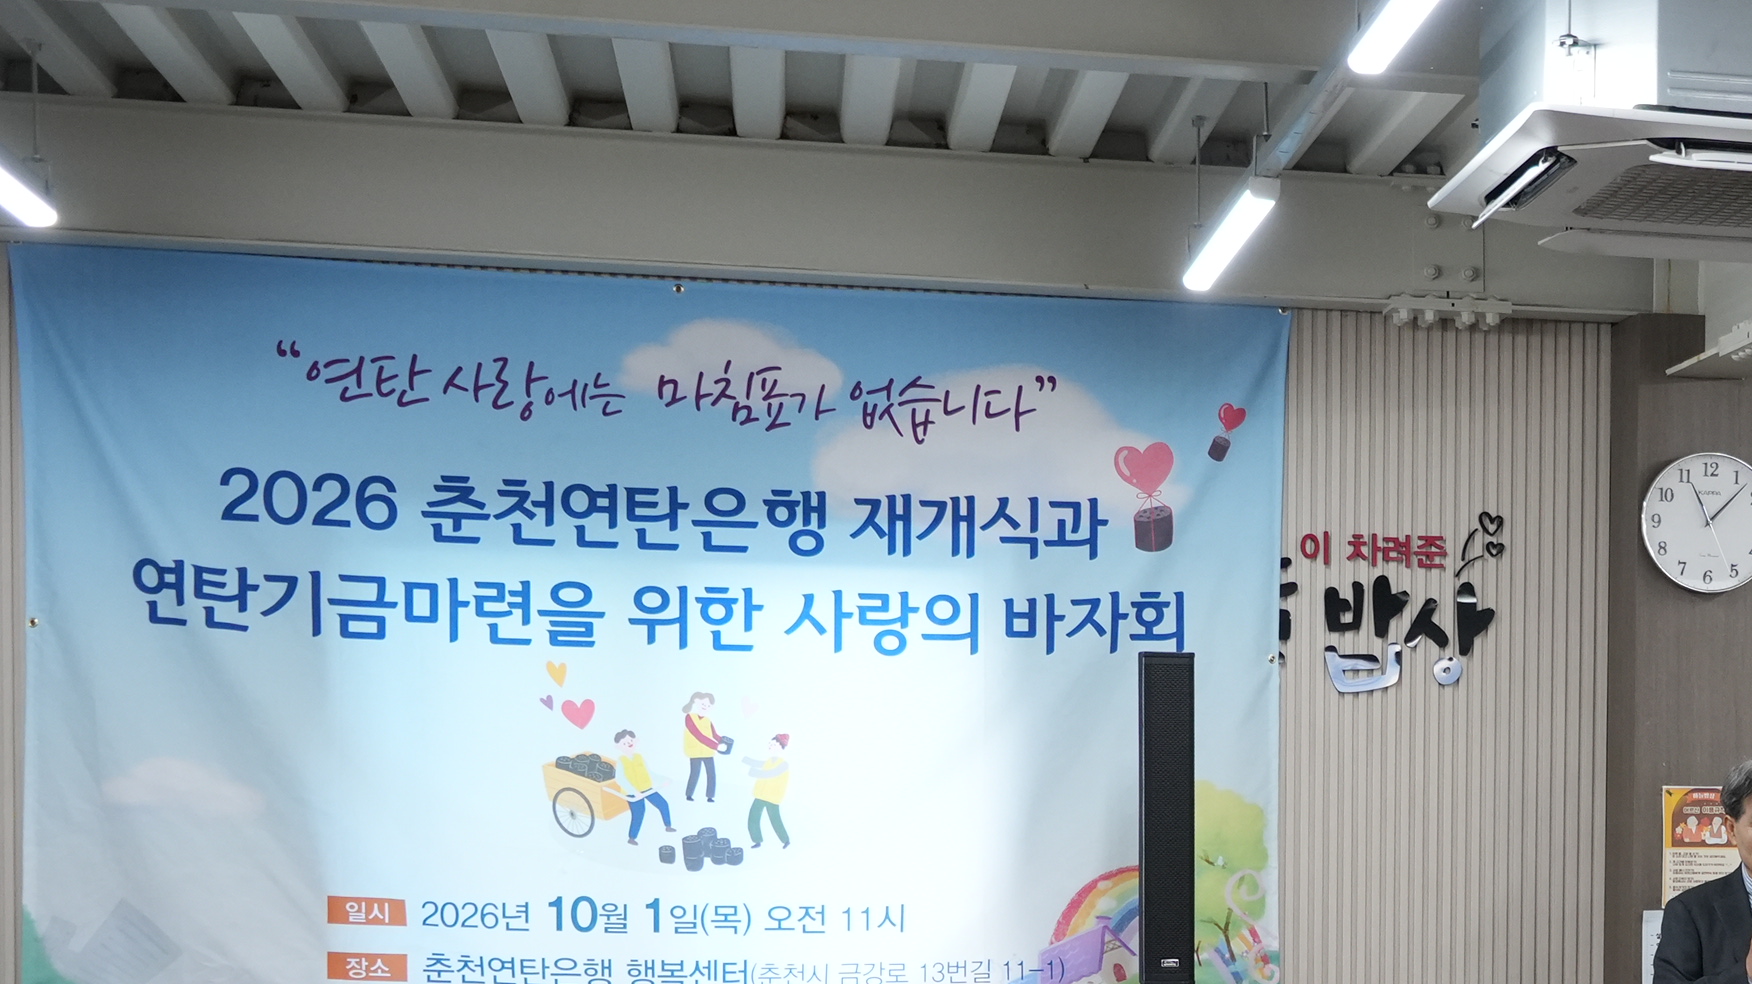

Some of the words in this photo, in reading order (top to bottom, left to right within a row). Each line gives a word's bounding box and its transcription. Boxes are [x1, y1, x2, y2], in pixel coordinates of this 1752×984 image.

[276, 340, 432, 407] “연탄
[443, 357, 625, 421] 사랑에는
[655, 357, 839, 434] 마침표가
[846, 374, 1060, 446] 없습니다”
[1678, 468, 1690, 483] 11
[1702, 462, 1719, 477] 12
[1733, 470, 1740, 485] 1
[1658, 488, 1674, 502] 10
[220, 467, 397, 530] 2026
[421, 475, 826, 557] 춘천연탄은행
[850, 493, 1109, 560] 재개식과
[1651, 514, 1661, 528] 9
[1300, 530, 1330, 566] 이
[1345, 532, 1449, 569] 차려준
[1658, 541, 1667, 556] 8
[1678, 560, 1687, 576] 7
[1703, 570, 1712, 584] 6
[1729, 564, 1738, 578] 5
[132, 556, 606, 648] 연탄기금마련을
[628, 585, 764, 651] 위한
[784, 590, 979, 656] 사랑의
[1003, 589, 1189, 655] 바자회
[1323, 574, 1496, 694] 밥상
[344, 900, 391, 924] 일시
[422, 901, 529, 931] 2026년
[549, 896, 627, 933] 10월
[646, 898, 751, 935] 1일(목)
[765, 905, 825, 933] 오전
[842, 904, 904, 932] 11시
[344, 956, 392, 980] 장소
[921, 959, 990, 983] 13번길
[1001, 956, 1066, 984] 11-1)
